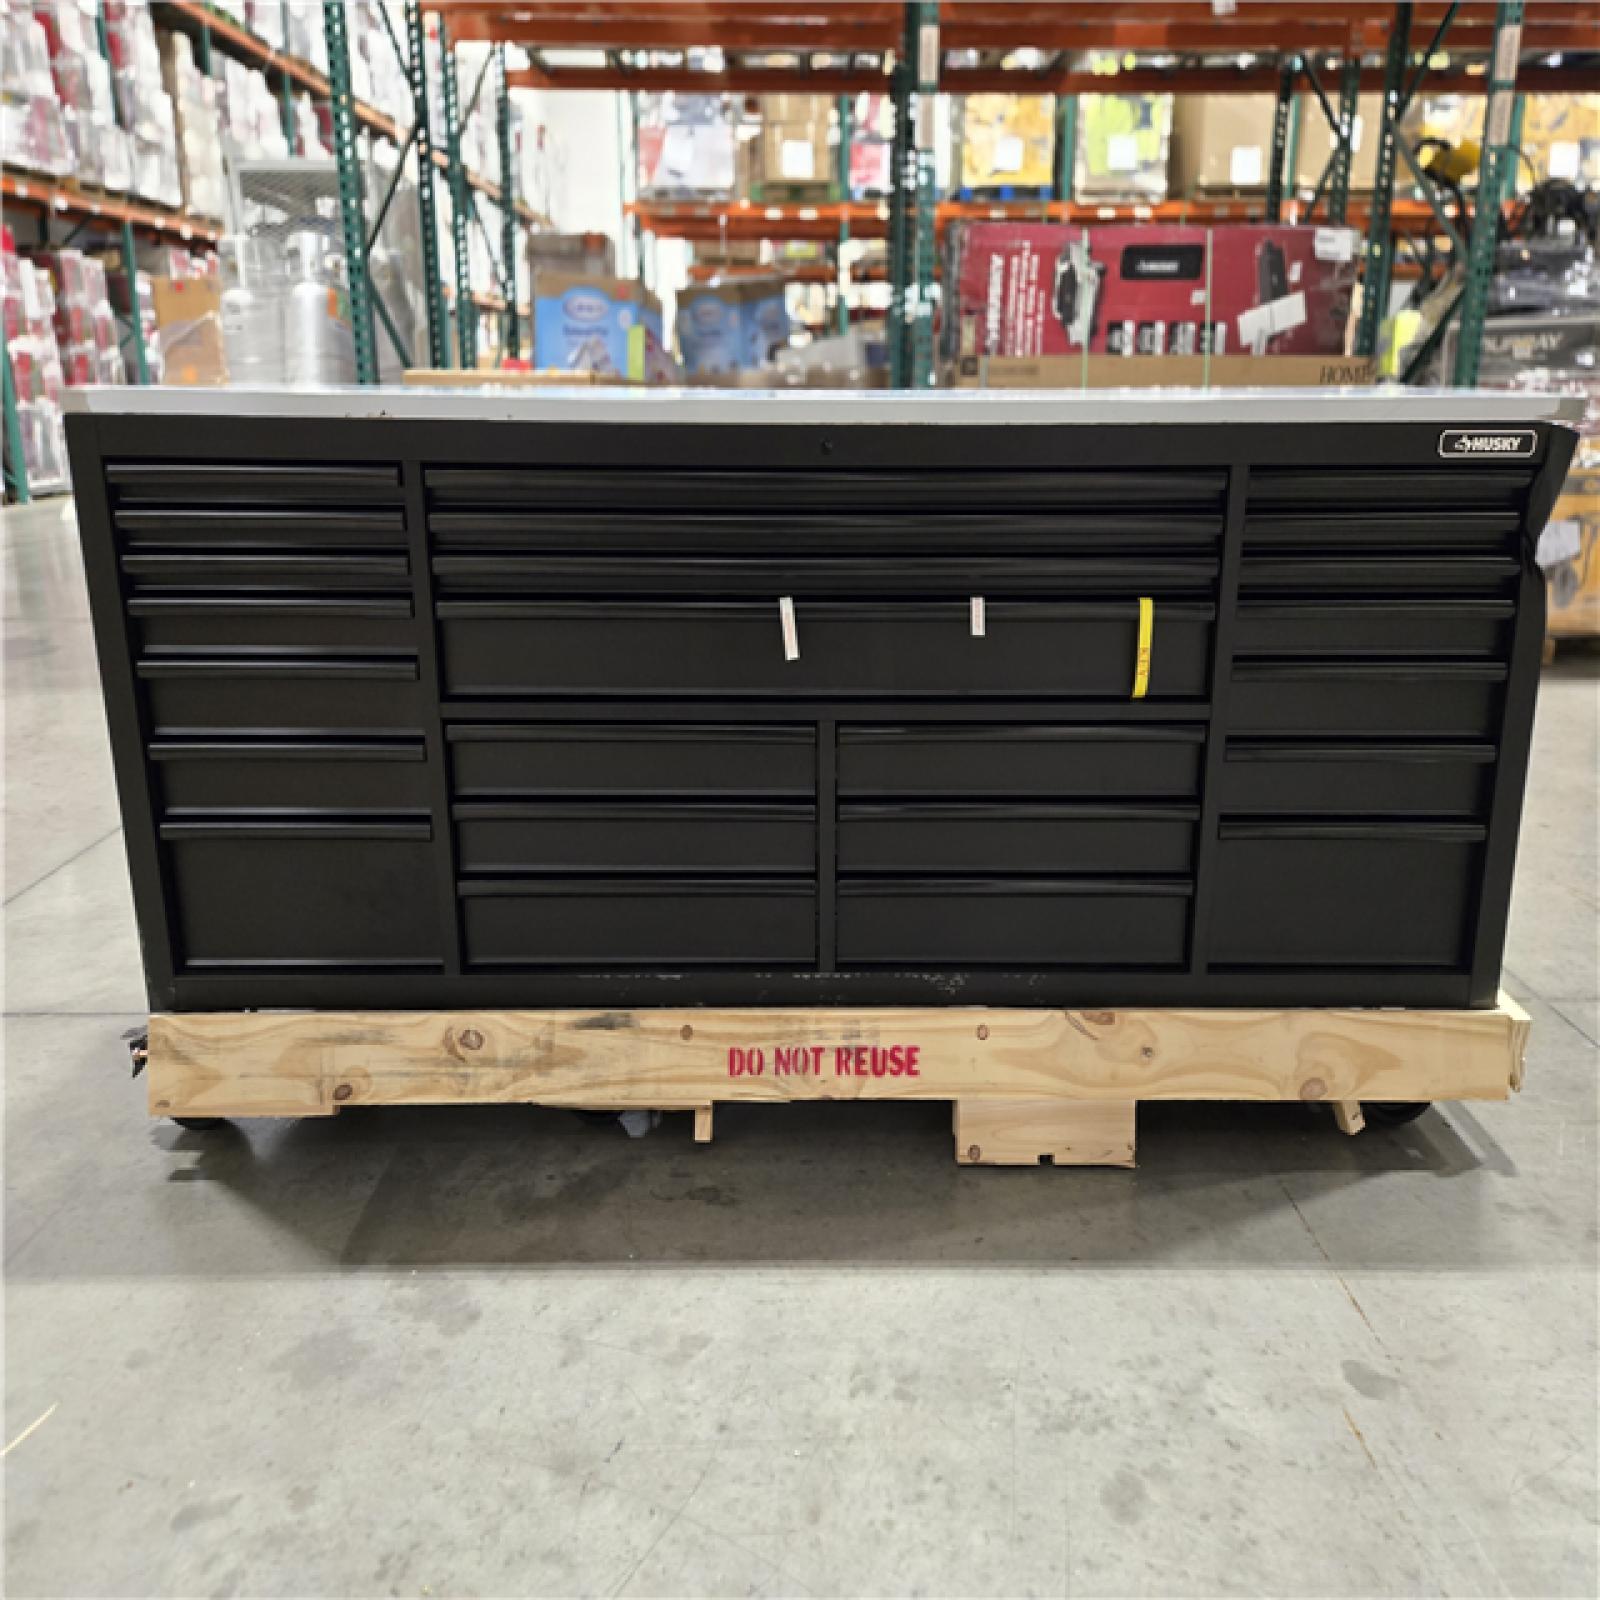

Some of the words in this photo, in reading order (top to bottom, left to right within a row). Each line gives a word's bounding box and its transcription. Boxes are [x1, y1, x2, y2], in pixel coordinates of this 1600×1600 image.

[1471, 437, 1521, 451] HUSKY
[729, 1047, 764, 1077] DO
[774, 1046, 825, 1077] NOT
[835, 1045, 920, 1077] REUSE
